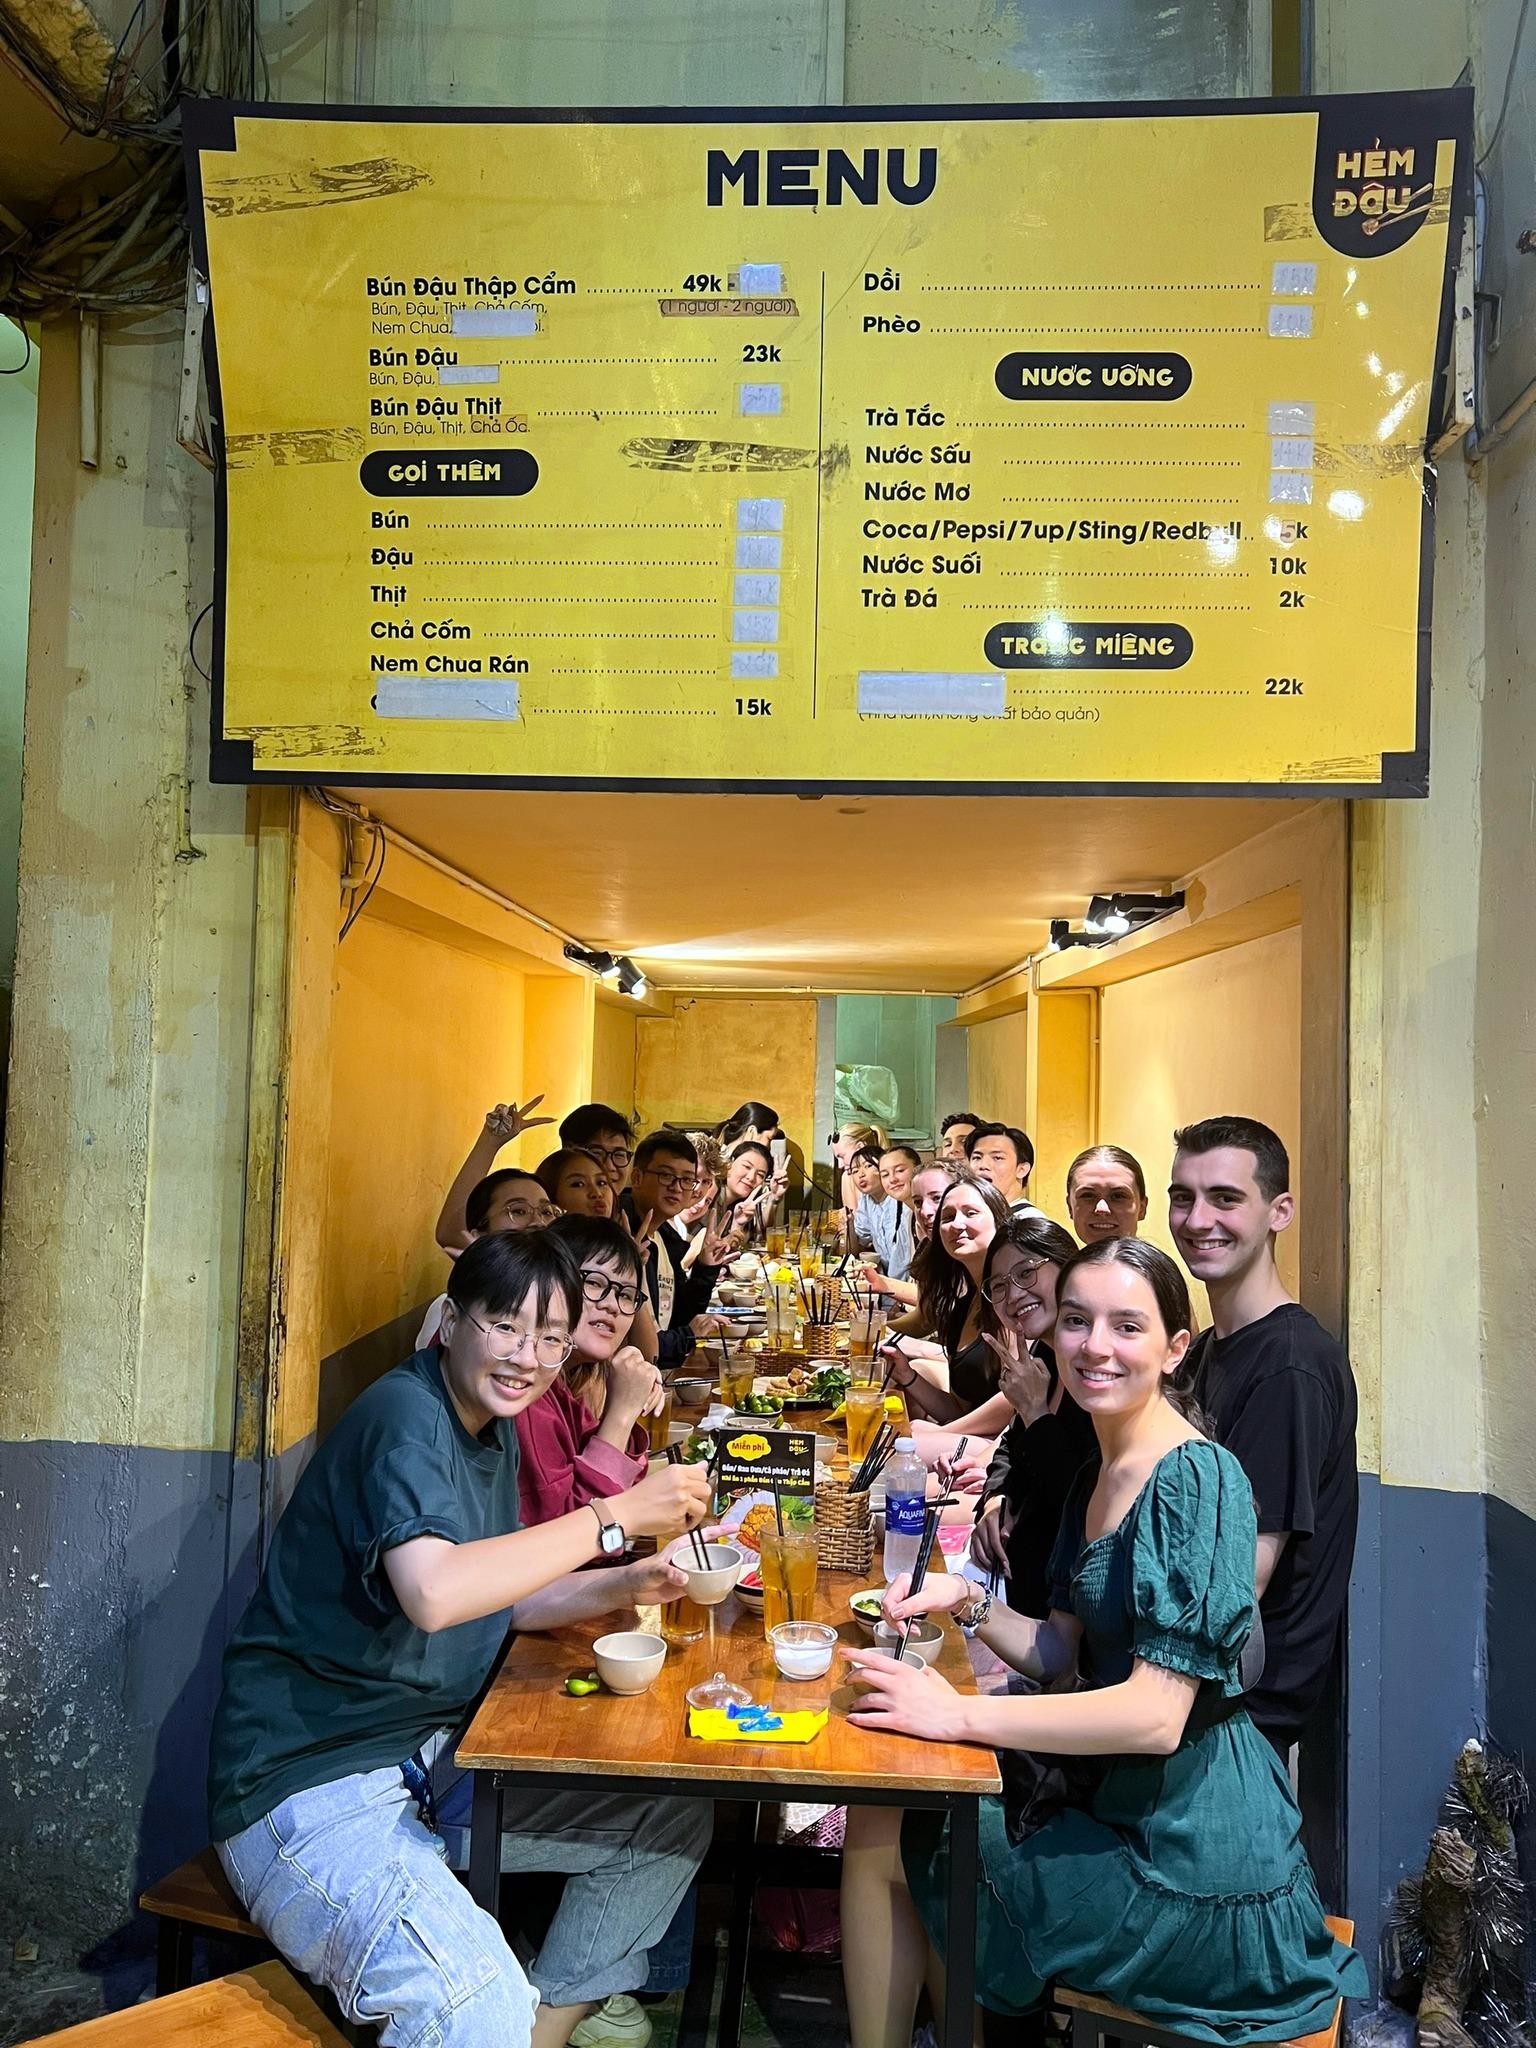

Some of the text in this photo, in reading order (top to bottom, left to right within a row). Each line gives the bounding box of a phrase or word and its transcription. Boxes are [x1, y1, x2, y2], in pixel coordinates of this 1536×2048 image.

[707, 147, 938, 207] MENU
[366, 275, 406, 297] Bún
[413, 276, 457, 301] Đậu
[463, 275, 517, 300] Thập
[523, 270, 576, 295] Cẩm
[682, 273, 722, 293] 49k
[864, 267, 900, 291] Dồi
[371, 301, 402, 317] Bún,
[405, 301, 440, 318] Đậu,
[371, 320, 406, 335] Nem
[863, 312, 921, 334] Phèo
[369, 344, 782, 371] Bún Đậu 23k
[369, 371, 436, 388] Bún, Đậu,
[1021, 363, 1174, 387] NƯỚC UỐNG
[370, 396, 502, 421] Bún Đậu Thịt
[865, 403, 945, 427] Trà Tắc
[370, 421, 399, 436] Bún,
[403, 421, 436, 437] Đậu,
[440, 420, 466, 437] Thịt,
[470, 418, 502, 434] Chả
[865, 442, 971, 464] Nước Sấu
[436, 459, 501, 482] THÊM
[864, 480, 971, 502] Nước Mơ
[371, 509, 409, 529] Bún
[862, 519, 1242, 545] Coca/Pepsi/7up/Sting/Redbll
[370, 546, 413, 570] Đậu
[862, 551, 1307, 575] Nước Suối 10k
[370, 585, 407, 608] Thịt
[861, 587, 1305, 608] Trà Đá 2k
[370, 618, 471, 640] Chả Cốm
[370, 654, 529, 674] Nem Chua Rán
[1265, 678, 1304, 696] 22k
[735, 698, 772, 716] 15k
[1021, 704, 1052, 720] bảo
[1055, 705, 1101, 723] quản)
[898, 1508, 926, 1521] AQUAFIN
